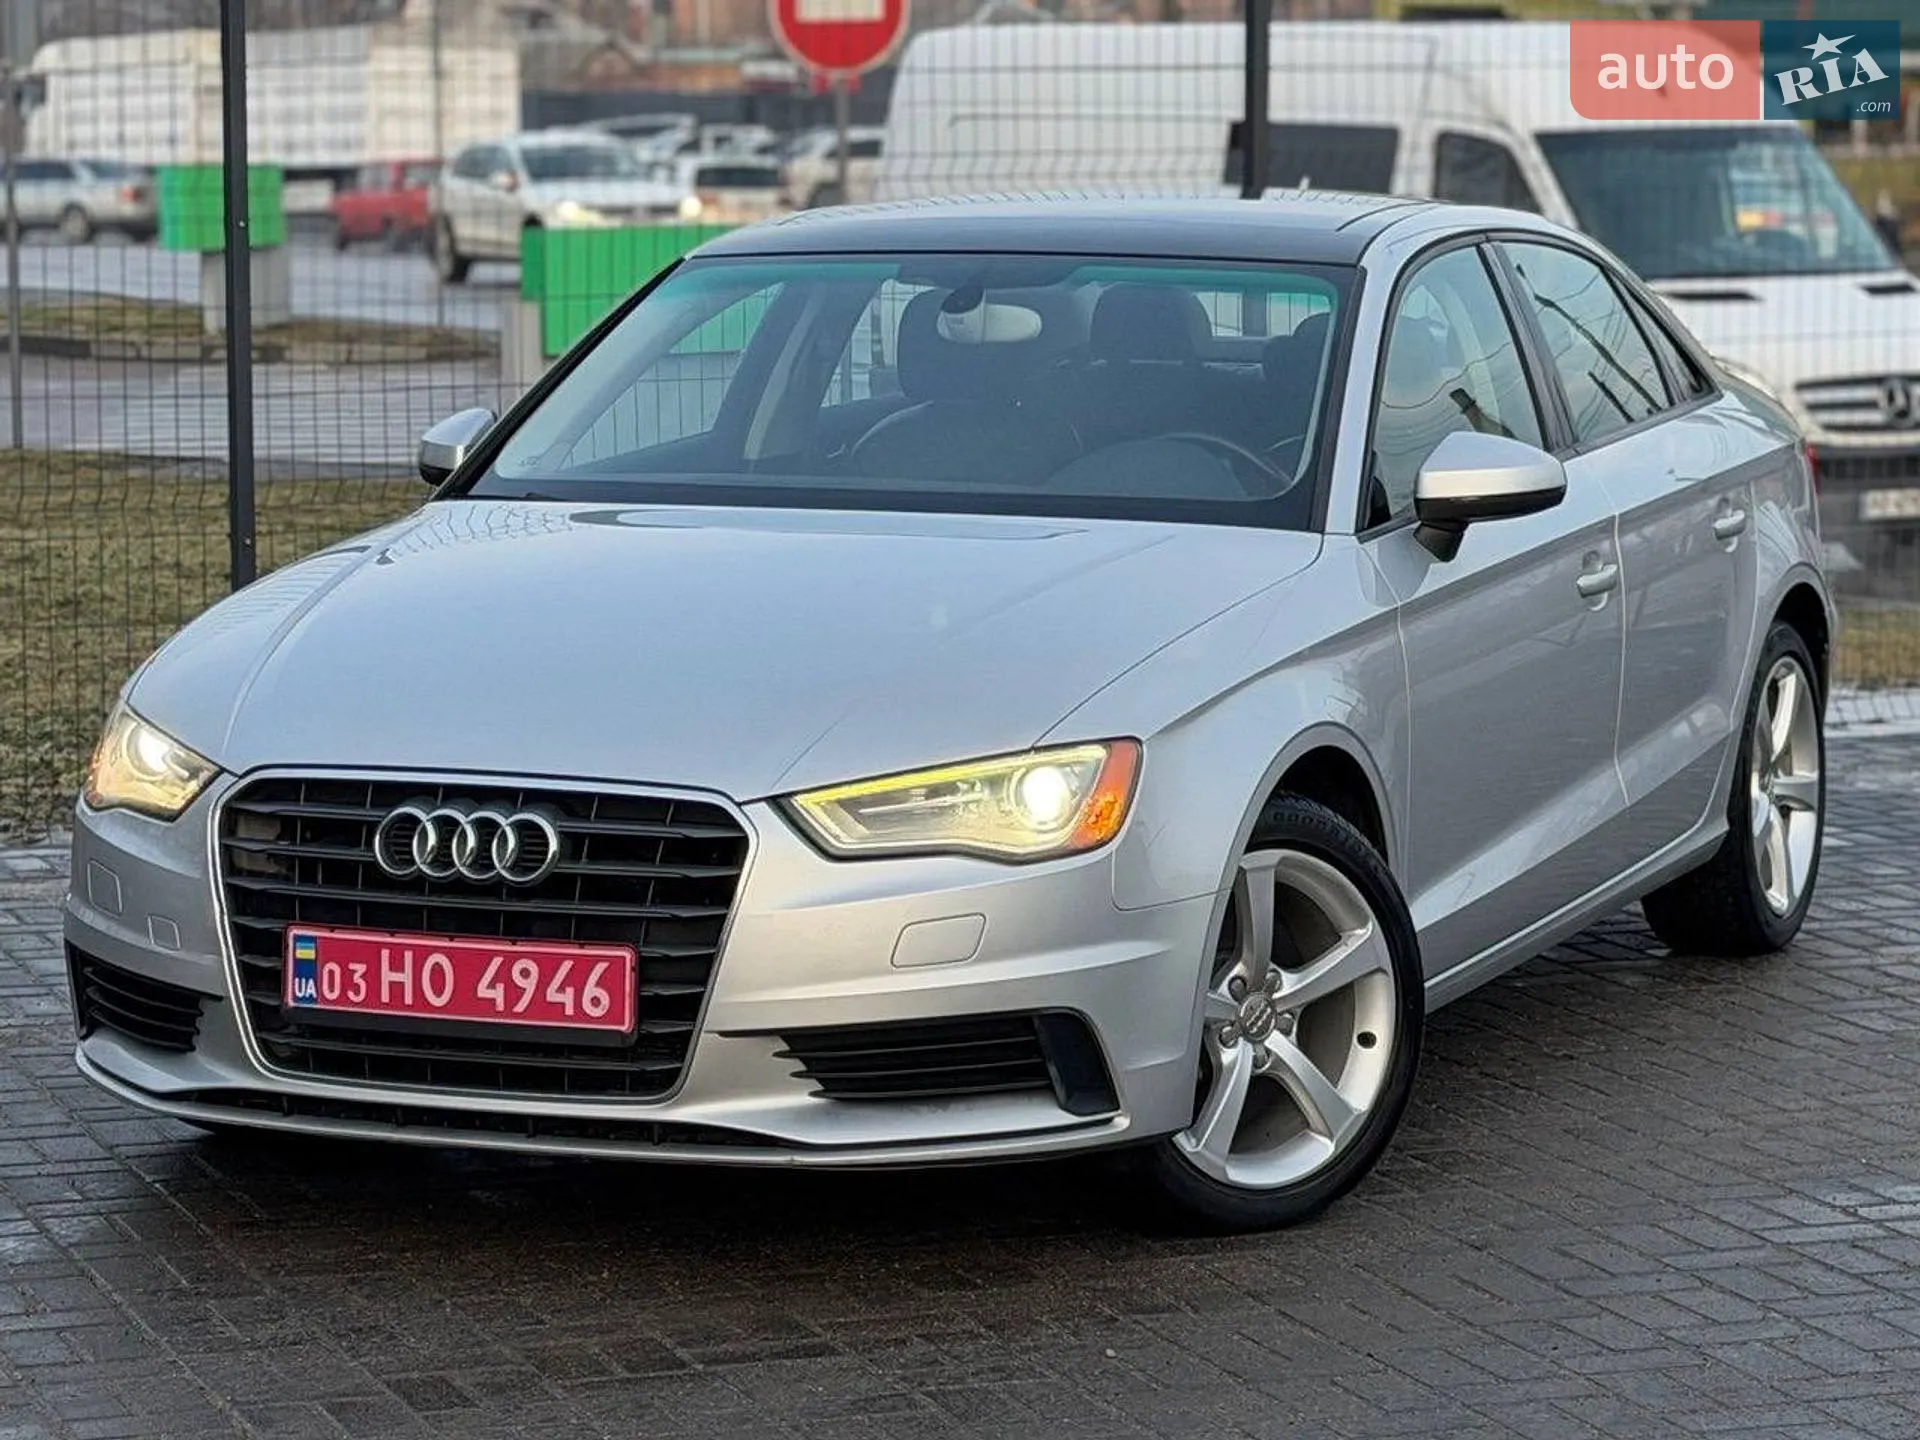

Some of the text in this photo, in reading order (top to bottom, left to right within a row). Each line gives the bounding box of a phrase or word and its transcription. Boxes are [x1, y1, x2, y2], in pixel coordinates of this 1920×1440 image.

[294, 977, 318, 998] UA
[322, 962, 368, 1003] 03
[476, 956, 611, 1018] 4946
